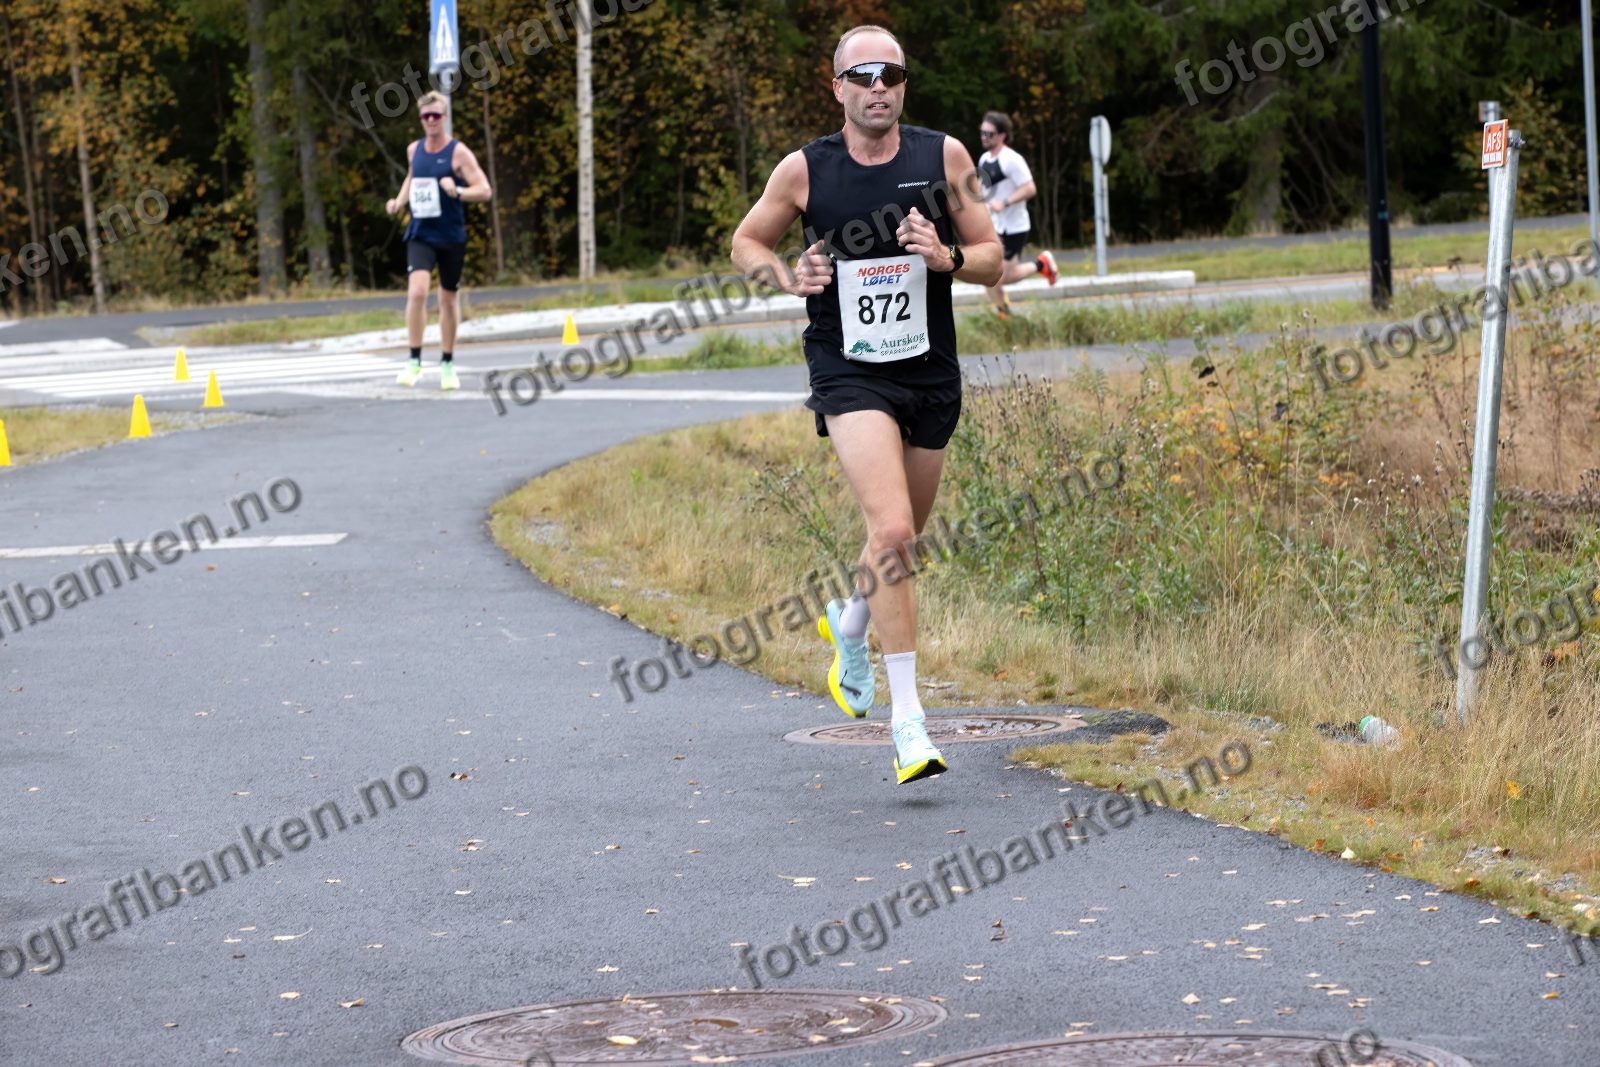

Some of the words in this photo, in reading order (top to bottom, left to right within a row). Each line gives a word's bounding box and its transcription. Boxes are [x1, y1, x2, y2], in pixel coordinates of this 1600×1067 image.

[1486, 131, 1502, 151] AFS
[857, 263, 911, 277] NORGES
[863, 274, 903, 286] LØPET
[858, 291, 911, 325] 872
[880, 332, 926, 349] Aurskog
